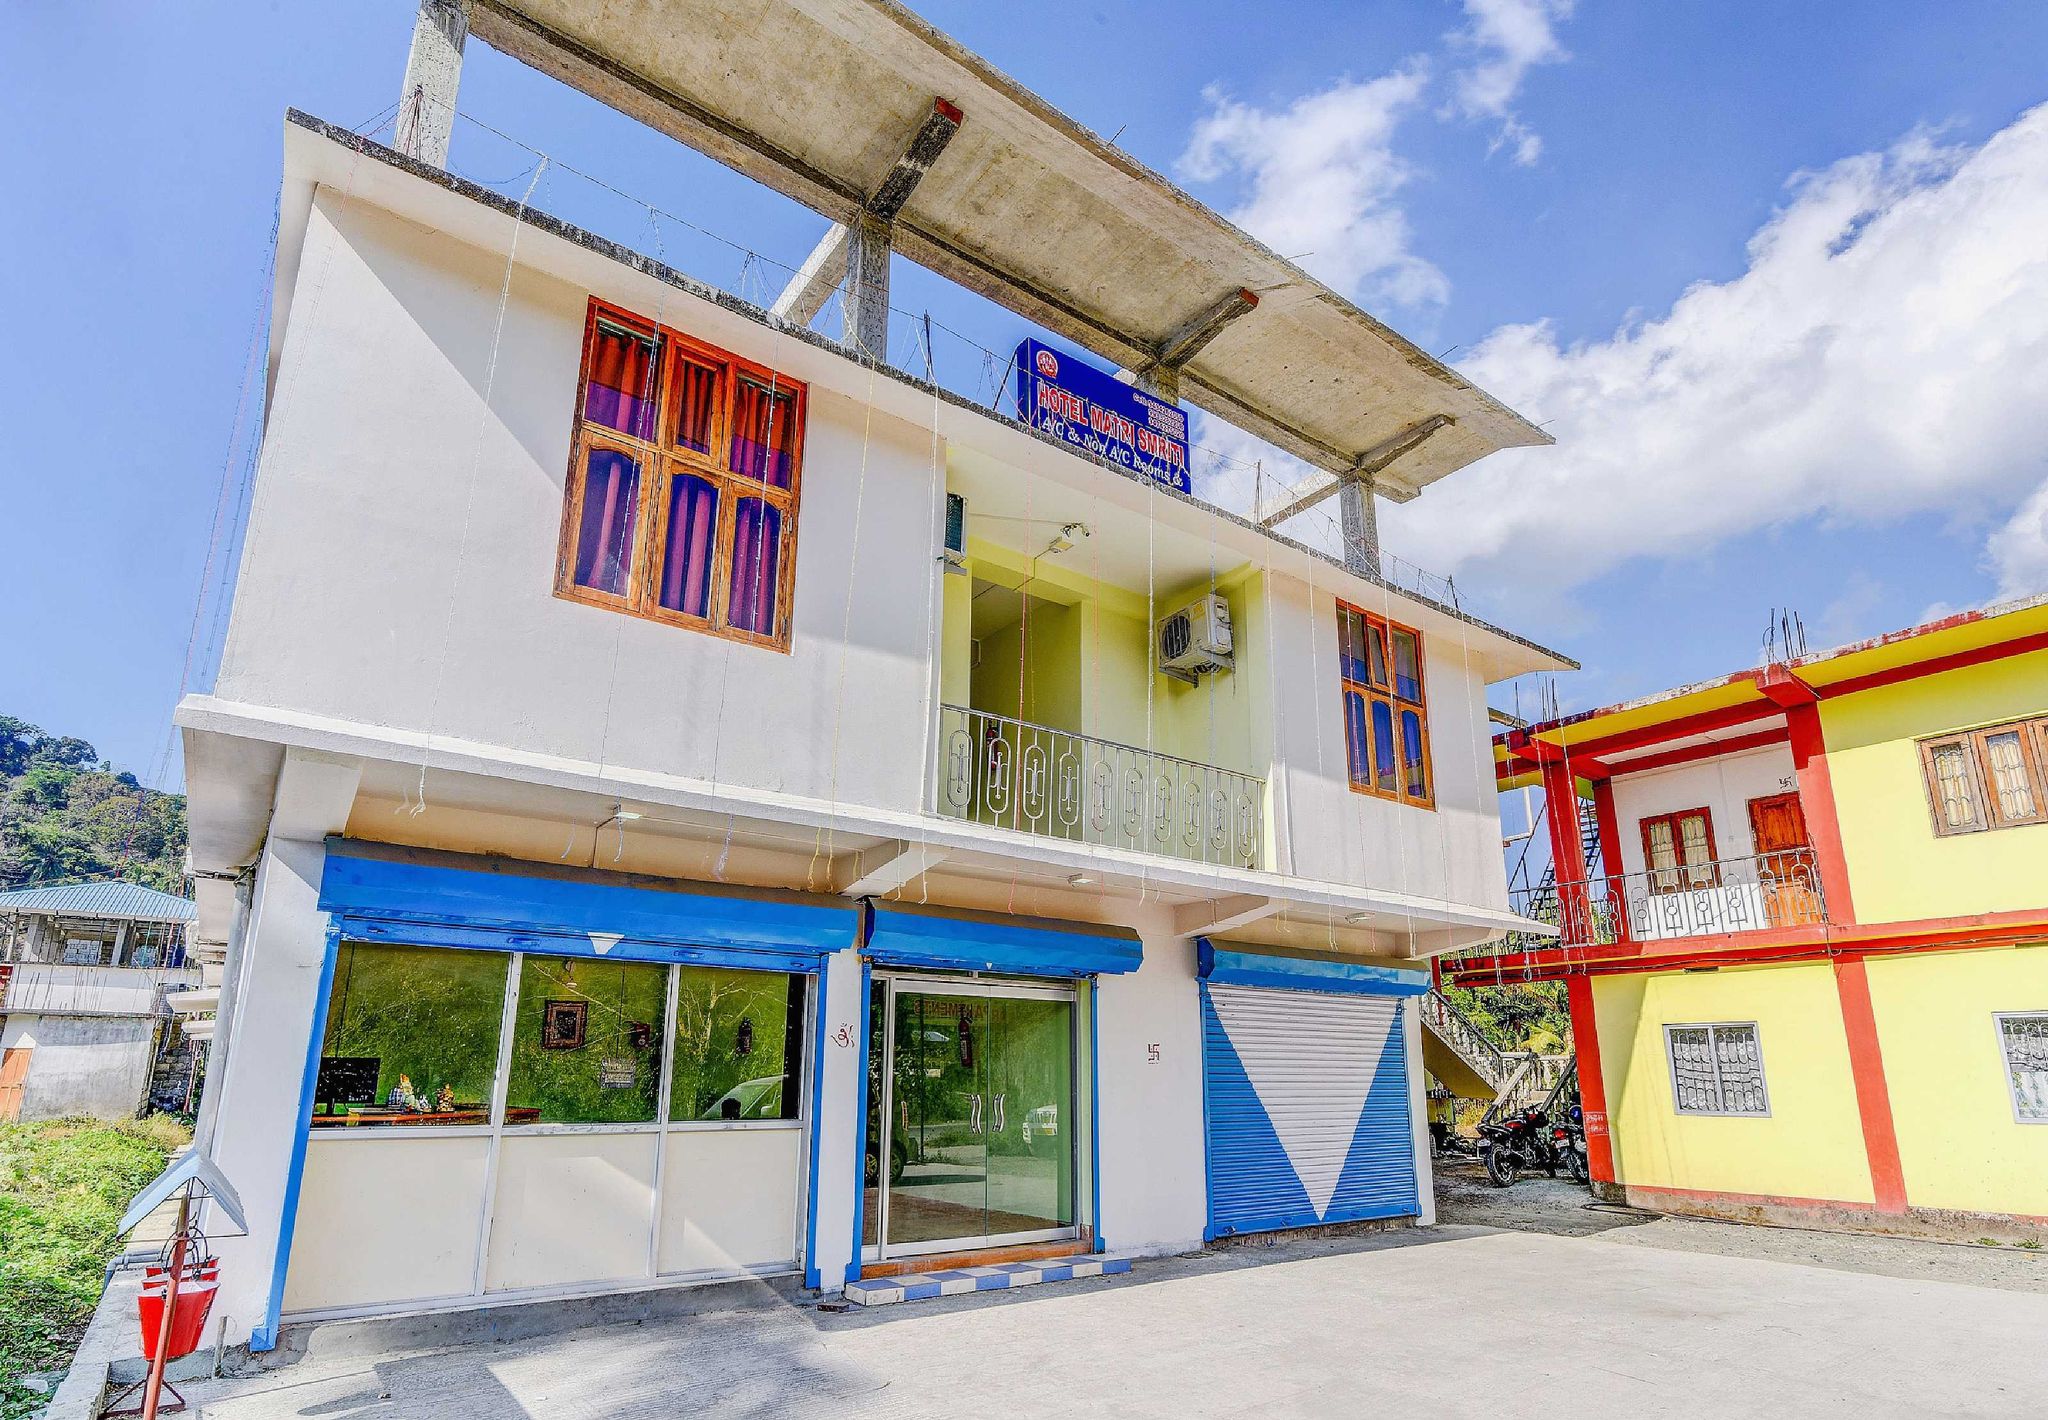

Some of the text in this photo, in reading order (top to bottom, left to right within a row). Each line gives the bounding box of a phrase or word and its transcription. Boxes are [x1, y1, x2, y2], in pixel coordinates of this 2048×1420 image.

[1039, 386, 1088, 426] HOTEL
[1090, 405, 1135, 447] MATRI
[1138, 428, 1184, 466] SMRITI
[1068, 428, 1080, 441] &
[1109, 445, 1130, 464] A/C
[1134, 456, 1170, 482] Rooms
